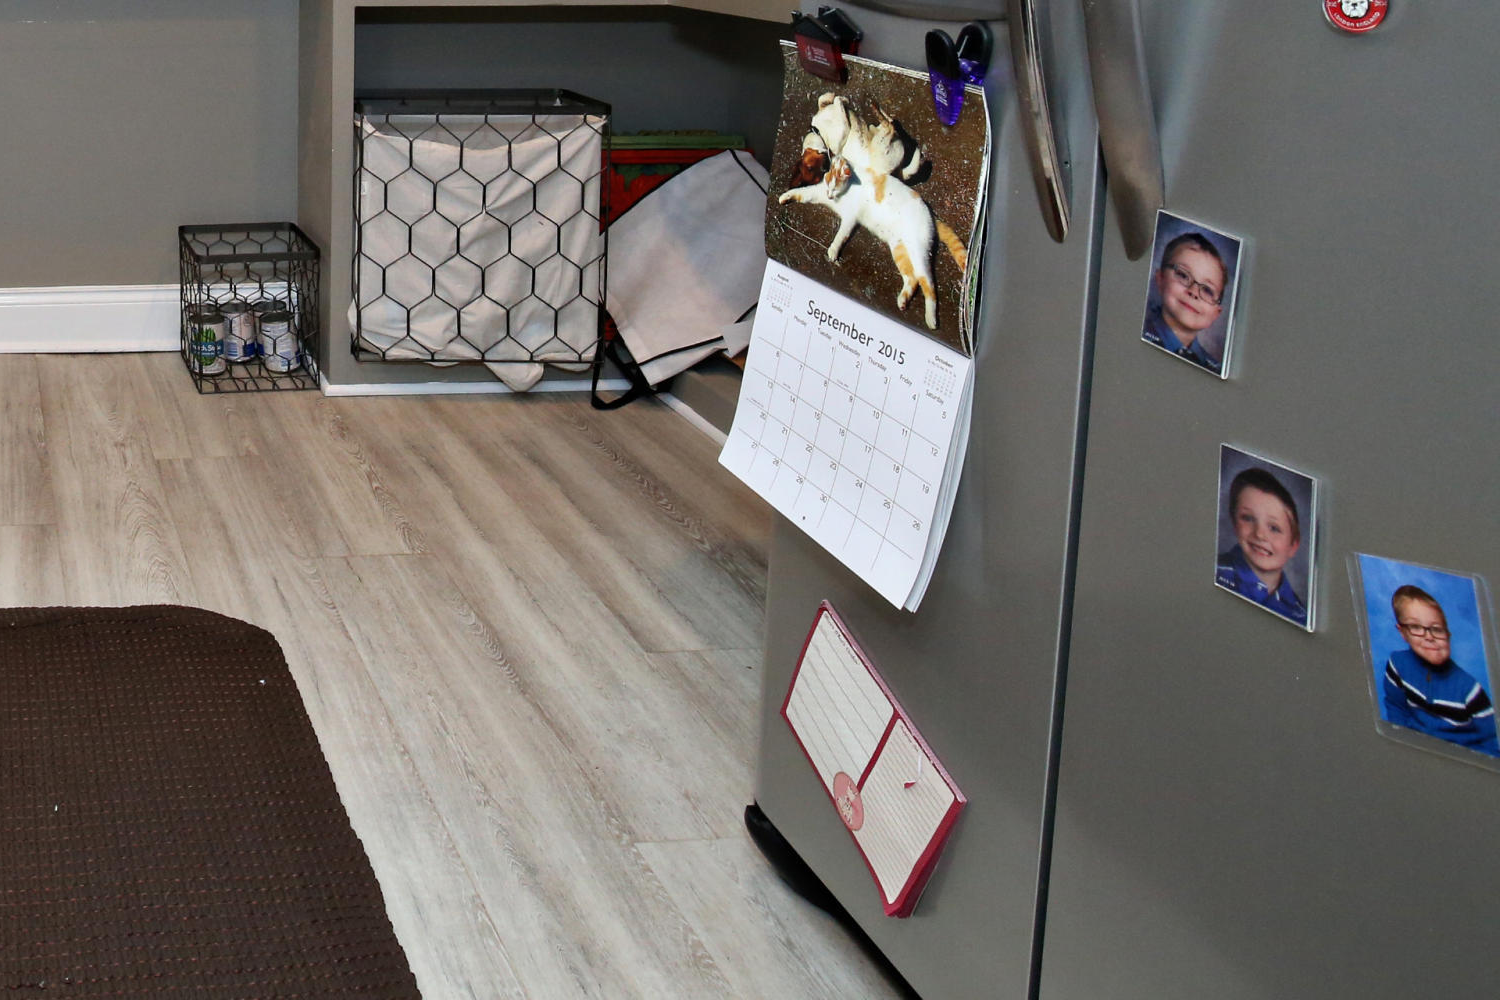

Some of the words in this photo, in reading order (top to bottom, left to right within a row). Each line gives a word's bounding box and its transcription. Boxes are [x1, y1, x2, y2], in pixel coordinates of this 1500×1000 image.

[1334, 12, 1355, 27] LONDON
[1356, 11, 1381, 27] ENGLAND
[807, 299, 874, 347] September
[878, 340, 906, 366] 2015
[934, 354, 954, 369] October
[817, 327, 832, 340] Tuesday
[838, 341, 861, 358] Wednesday
[868, 355, 888, 372] Thursday
[899, 373, 913, 387] Friday
[925, 389, 945, 406] Saturday
[855, 360, 861, 369] 2
[883, 376, 889, 385] 3
[911, 393, 917, 402] 4
[941, 410, 947, 419] 5
[767, 380, 774, 389] 13
[789, 395, 796, 404] 14
[814, 411, 821, 420] 15
[838, 427, 845, 437] 16
[864, 445, 872, 454] 17
[892, 463, 900, 474] 18
[922, 483, 930, 494] 19
[823, 379, 828, 387] 8
[849, 395, 854, 403] 9
[872, 409, 880, 420] 10
[901, 428, 909, 438] 11
[931, 446, 939, 457] 12
[751, 441, 758, 449] 27
[772, 457, 780, 467] 28
[795, 475, 804, 485] 29
[820, 493, 828, 504] 30
[759, 411, 767, 421] 20
[781, 426, 789, 436] 21
[805, 443, 813, 453] 22
[829, 460, 837, 471] 23
[855, 479, 863, 489] 24
[883, 498, 891, 510] 25
[912, 519, 921, 532] 26
